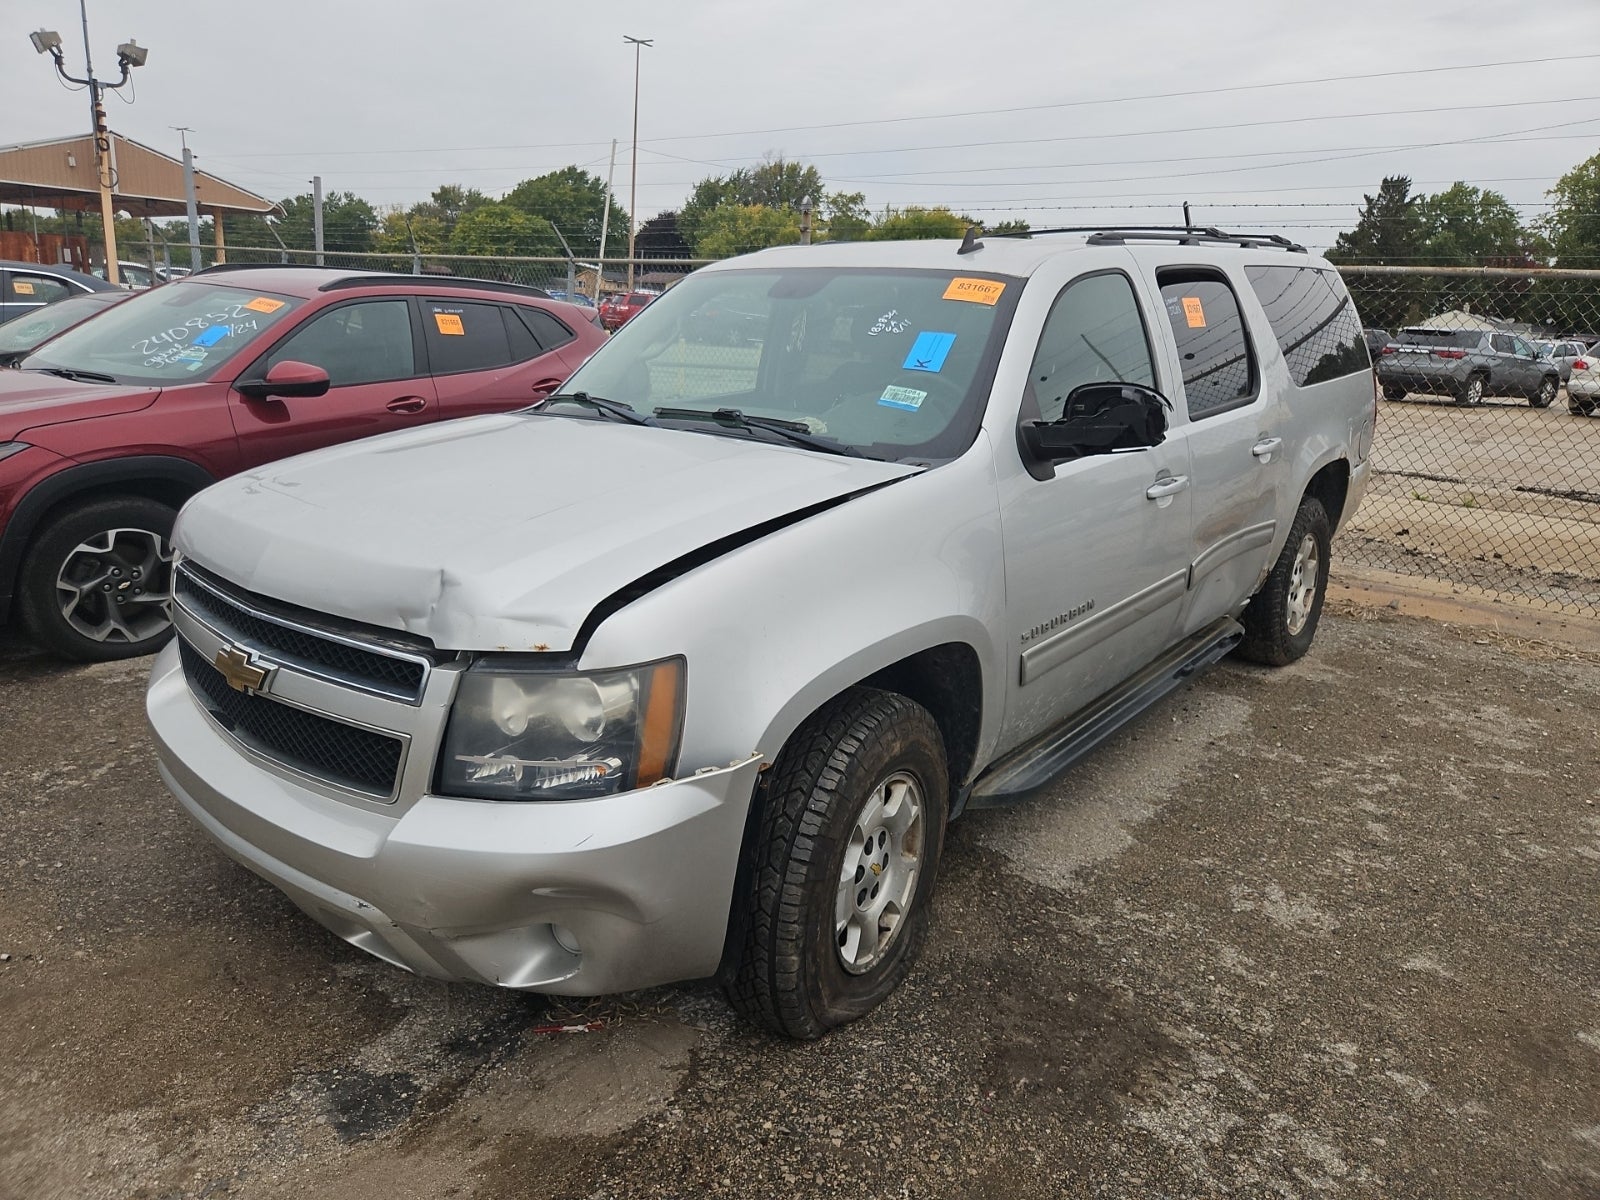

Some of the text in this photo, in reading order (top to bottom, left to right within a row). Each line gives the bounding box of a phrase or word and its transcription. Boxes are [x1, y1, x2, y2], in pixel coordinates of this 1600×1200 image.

[957, 282, 999, 294] 831667
[132, 304, 249, 355] 240852
[913, 358, 932, 369] K
[1020, 599, 1095, 645] SUBURBAN
